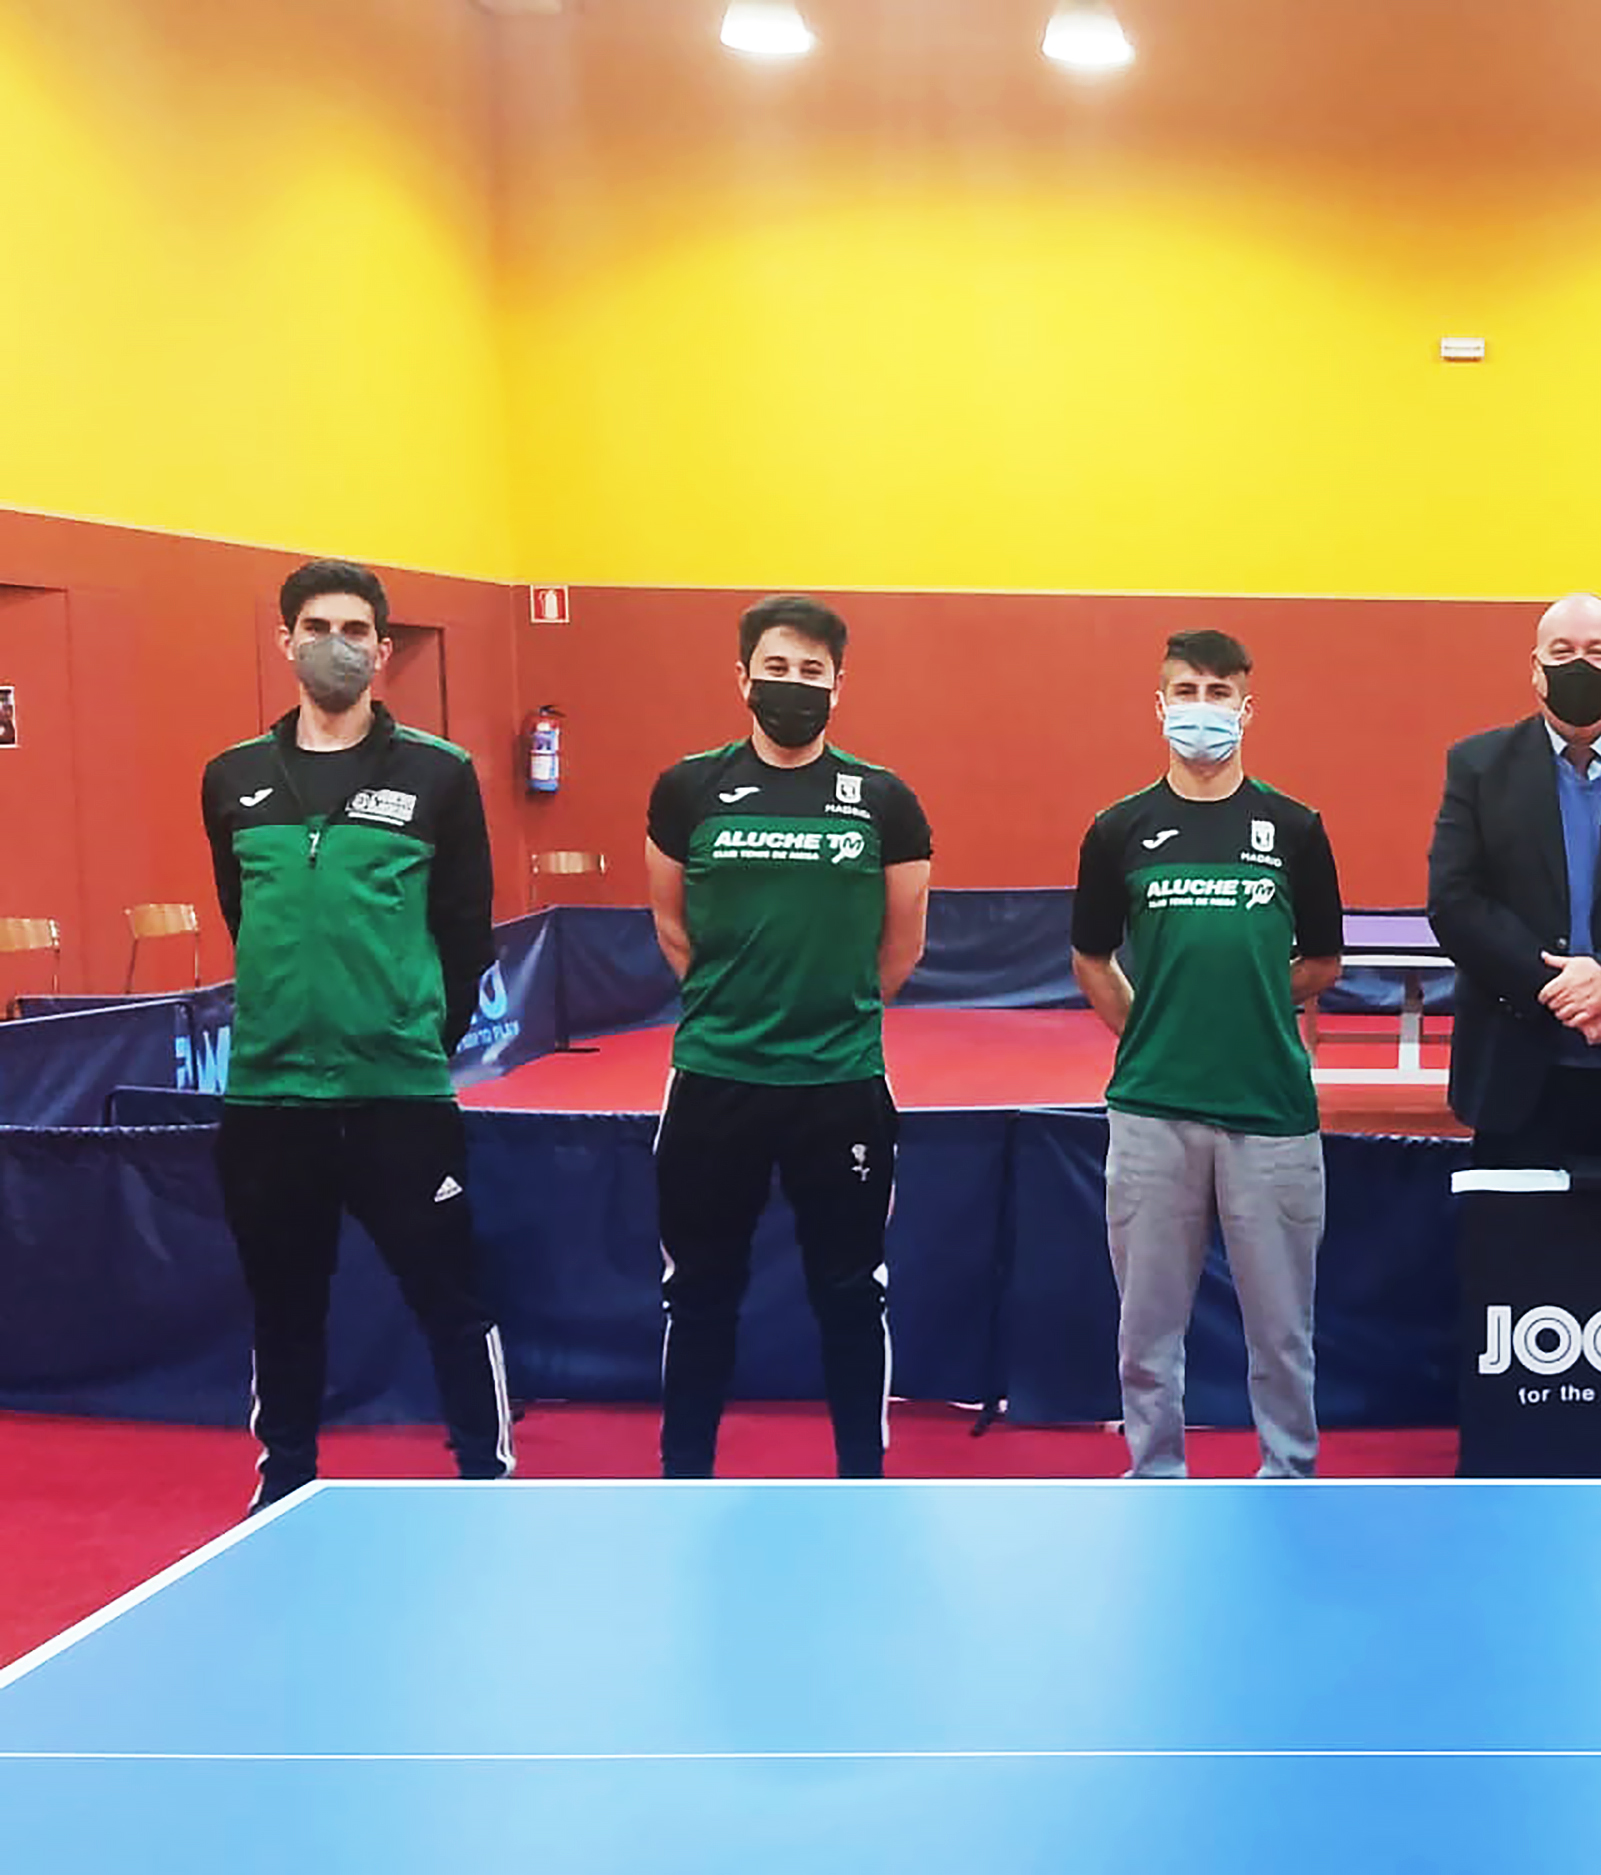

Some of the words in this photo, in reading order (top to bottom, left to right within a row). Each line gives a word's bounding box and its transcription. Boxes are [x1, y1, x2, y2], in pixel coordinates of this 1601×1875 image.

[714, 831, 822, 849] ALUCHE
[1240, 851, 1283, 867] MADRID
[1147, 879, 1239, 898] ALUCHE
[1518, 1387, 1551, 1405] for
[1560, 1384, 1596, 1402] the
